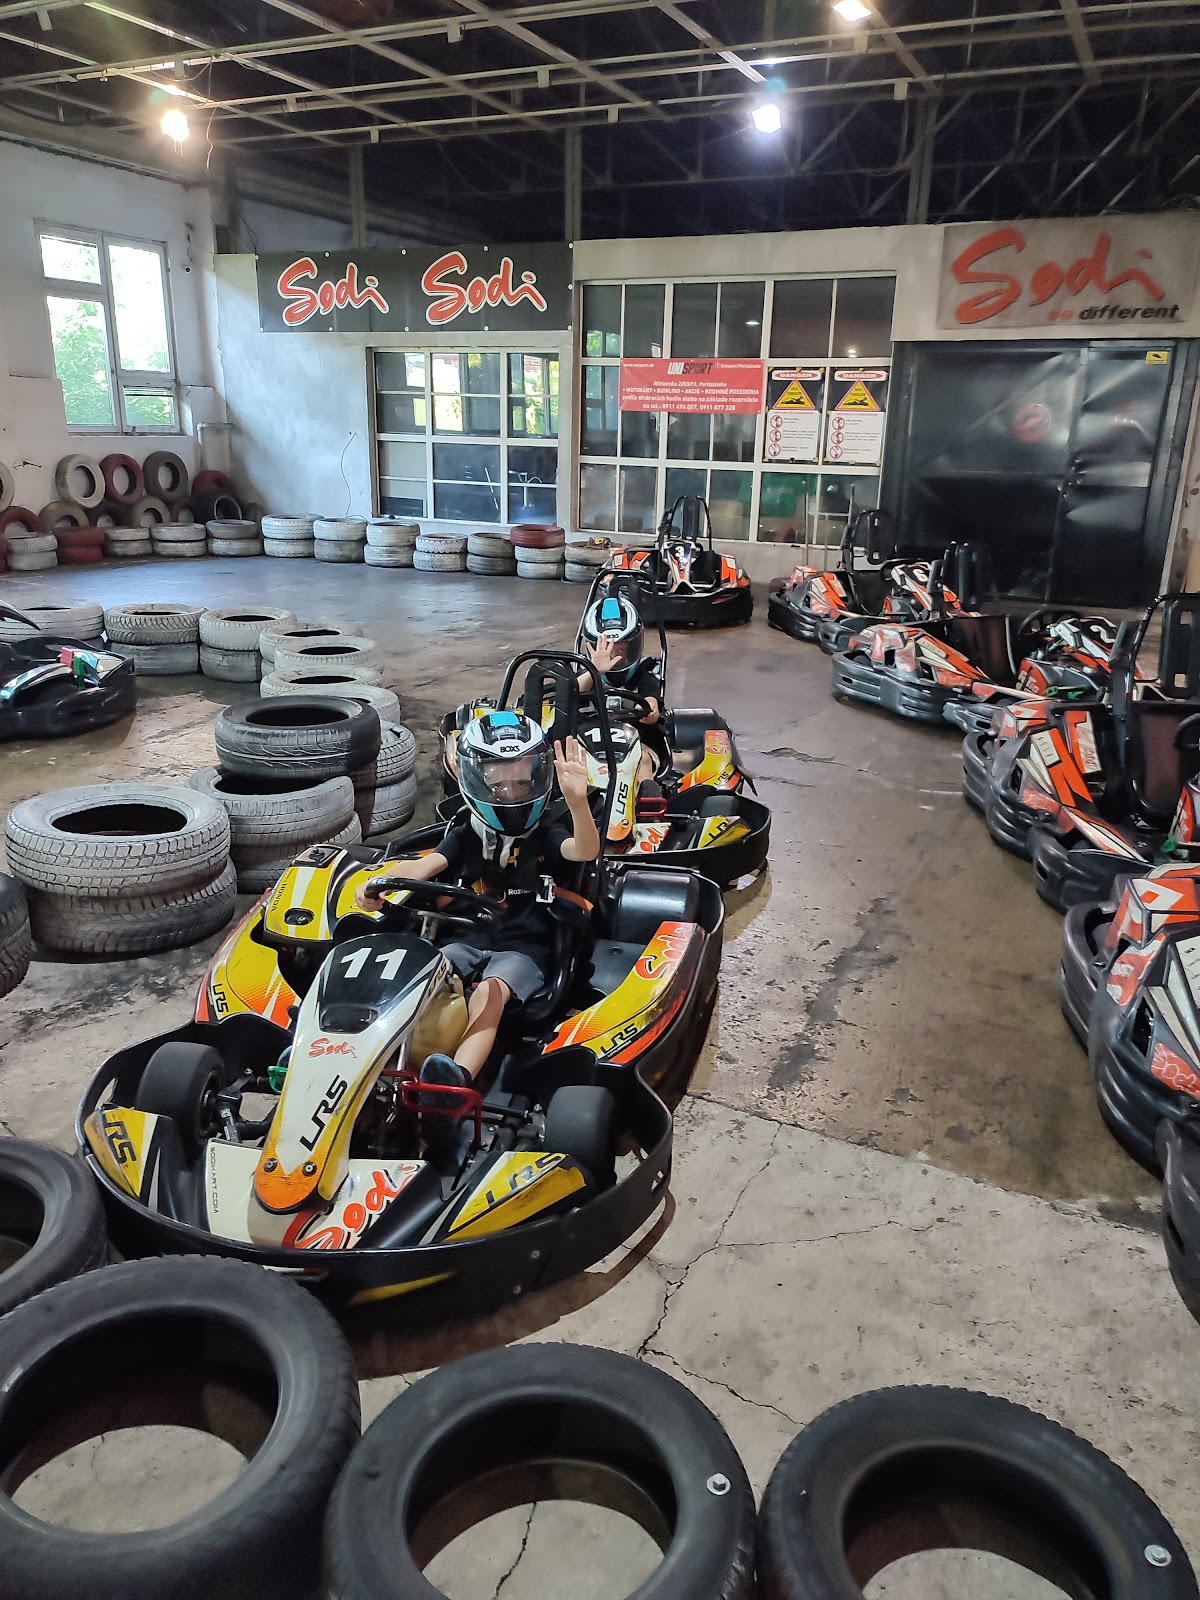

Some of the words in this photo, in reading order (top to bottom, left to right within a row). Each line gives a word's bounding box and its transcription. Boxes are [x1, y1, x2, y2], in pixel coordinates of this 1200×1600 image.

[278, 257, 389, 326] Sodi
[421, 250, 548, 325] Sodi
[952, 227, 1166, 324] Sodi
[1079, 304, 1180, 320] different
[667, 361, 713, 375] UNISPORT
[675, 546, 685, 557] 3
[912, 568, 928, 582] 6
[500, 745, 521, 753] BOXS
[584, 727, 627, 743] 12
[615, 782, 629, 815] LRS
[271, 882, 288, 912] HONDA
[341, 947, 408, 980] 11
[212, 983, 230, 1013] LRS
[308, 1037, 358, 1058] Sodi
[599, 1022, 638, 1054] LRS
[300, 1074, 348, 1152] LRS
